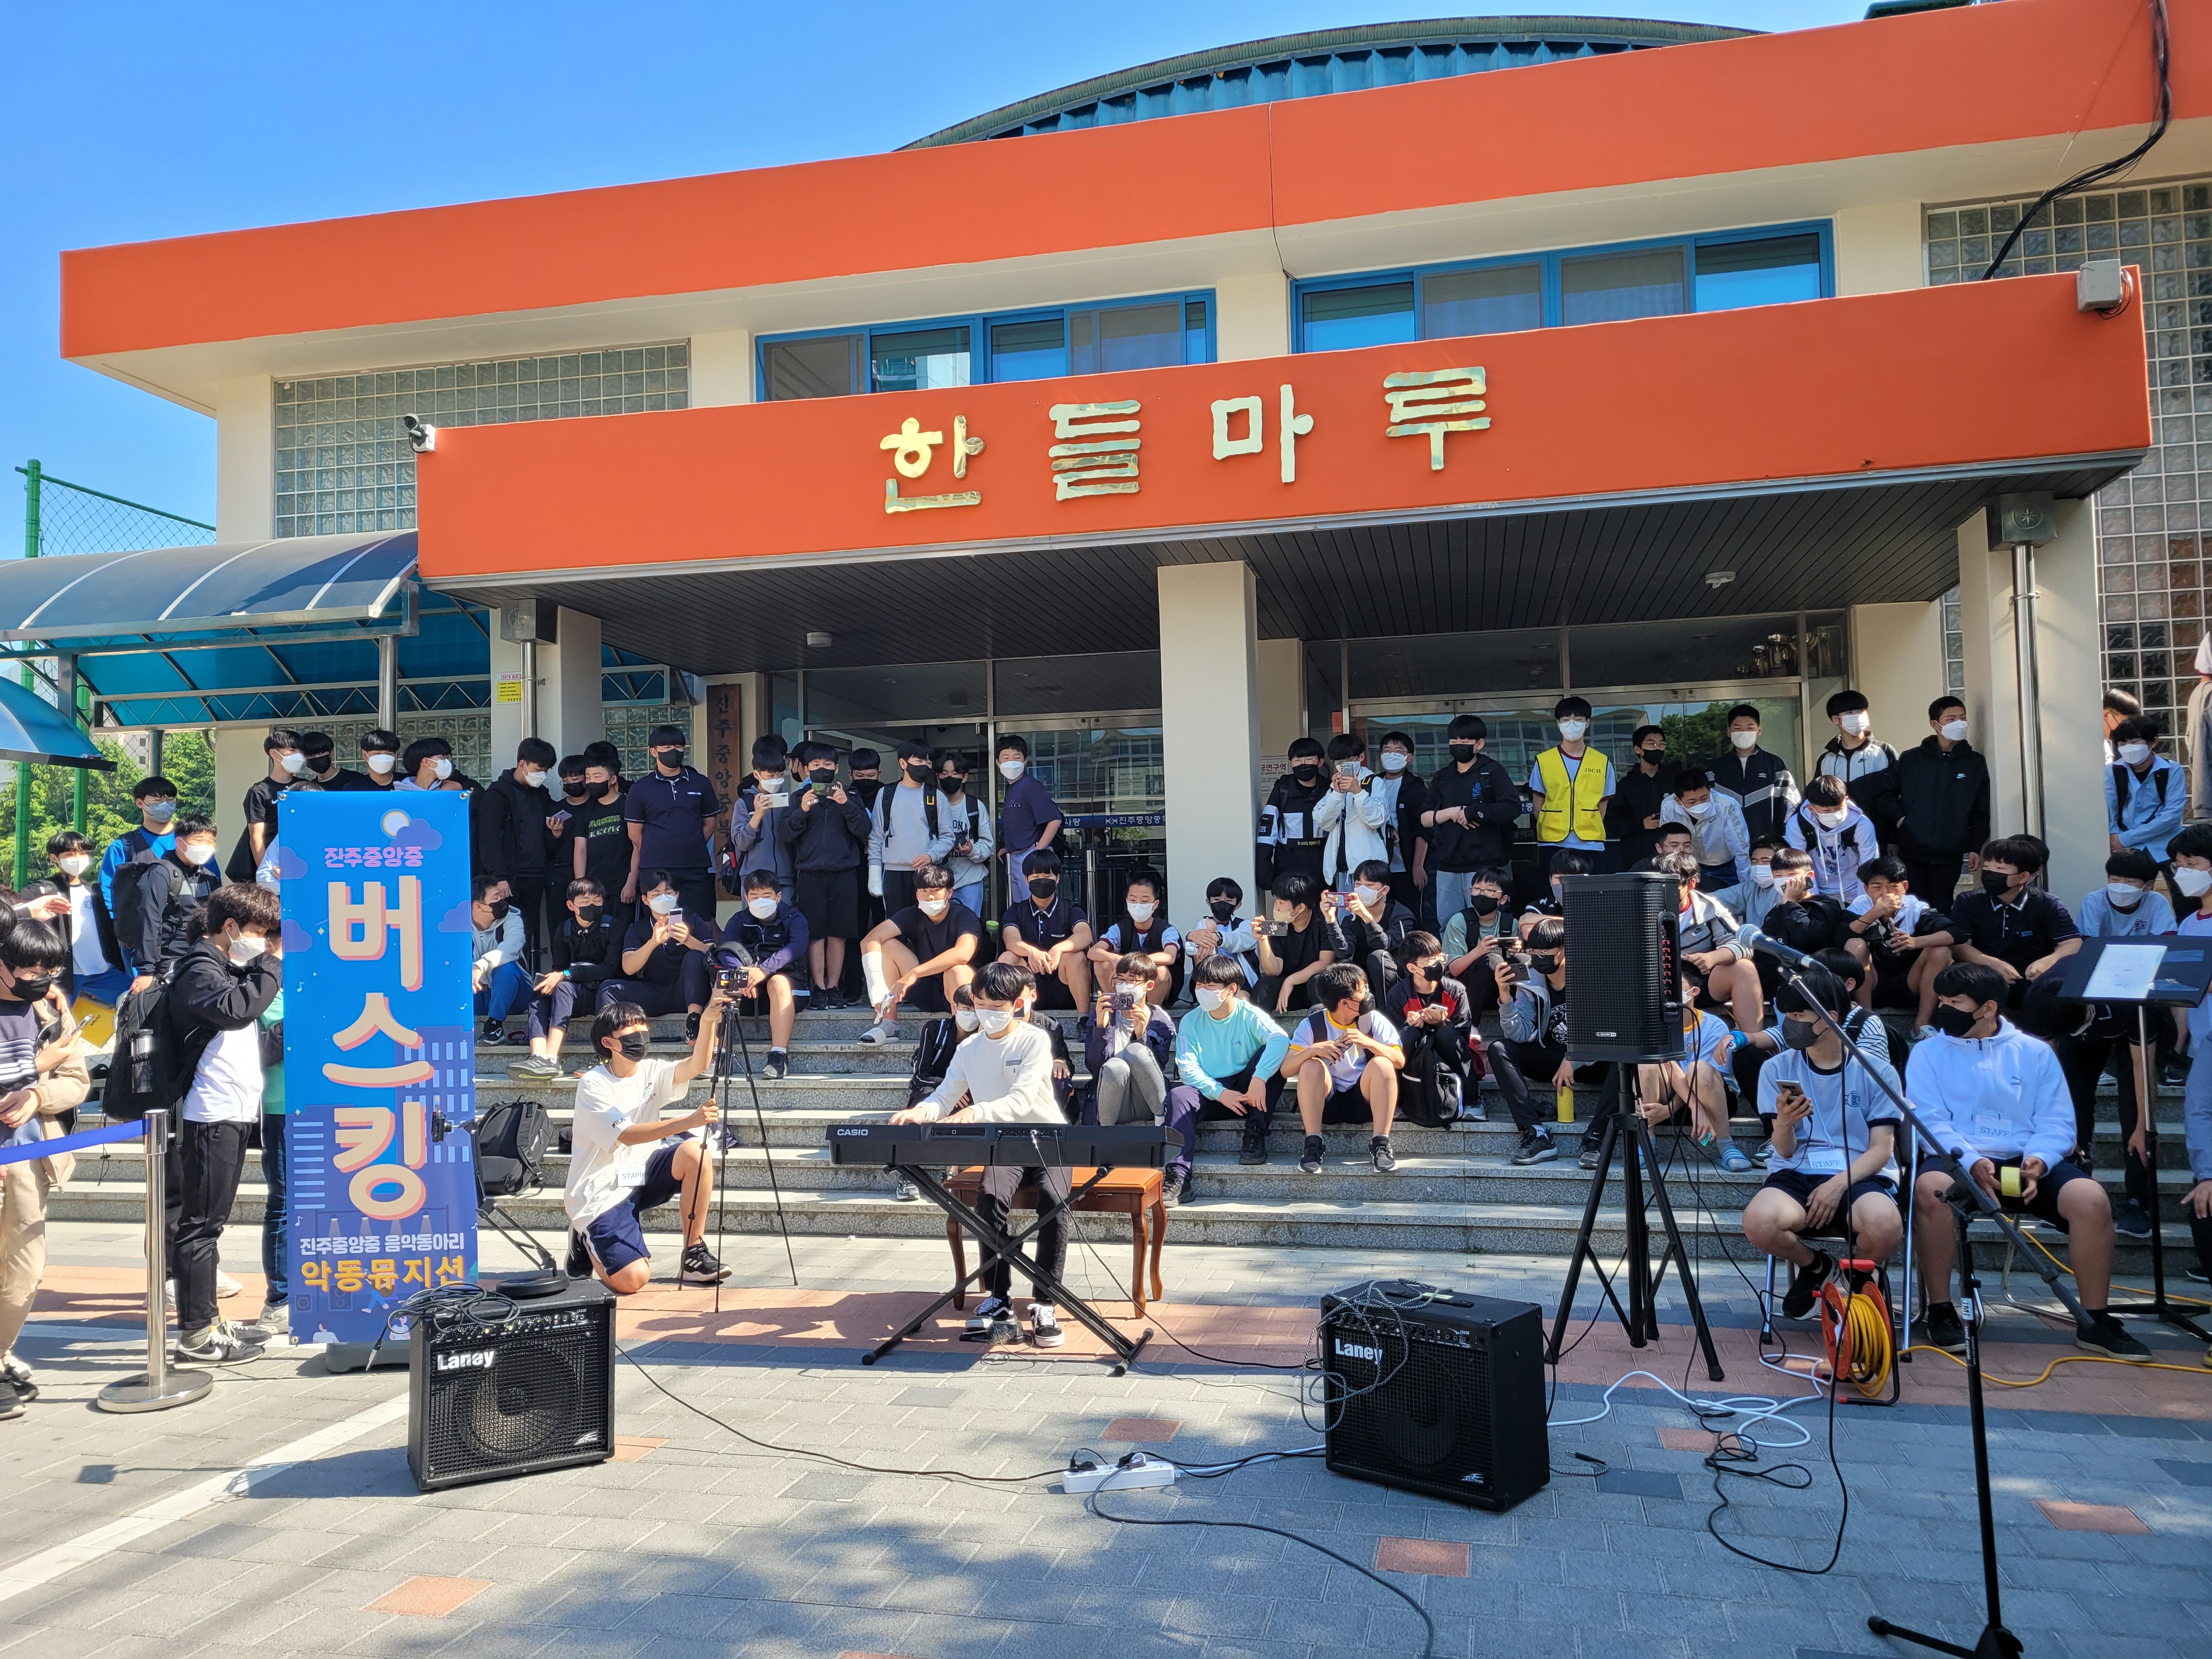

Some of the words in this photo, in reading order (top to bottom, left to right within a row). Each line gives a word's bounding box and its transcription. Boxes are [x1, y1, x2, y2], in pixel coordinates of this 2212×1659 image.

[879, 366, 1492, 515] 한들마루
[324, 847, 424, 868] 진주중앙중
[321, 874, 435, 1221] 버스킹
[837, 1128, 868, 1136] CASIO
[1980, 1126, 2010, 1137] STAFF
[1812, 1159, 1840, 1169] STAFF
[300, 1235, 380, 1255] 진주중앙중
[384, 1232, 464, 1252] 음악동아리
[437, 1350, 495, 1371] Laney
[1335, 1338, 1383, 1365] Laney
